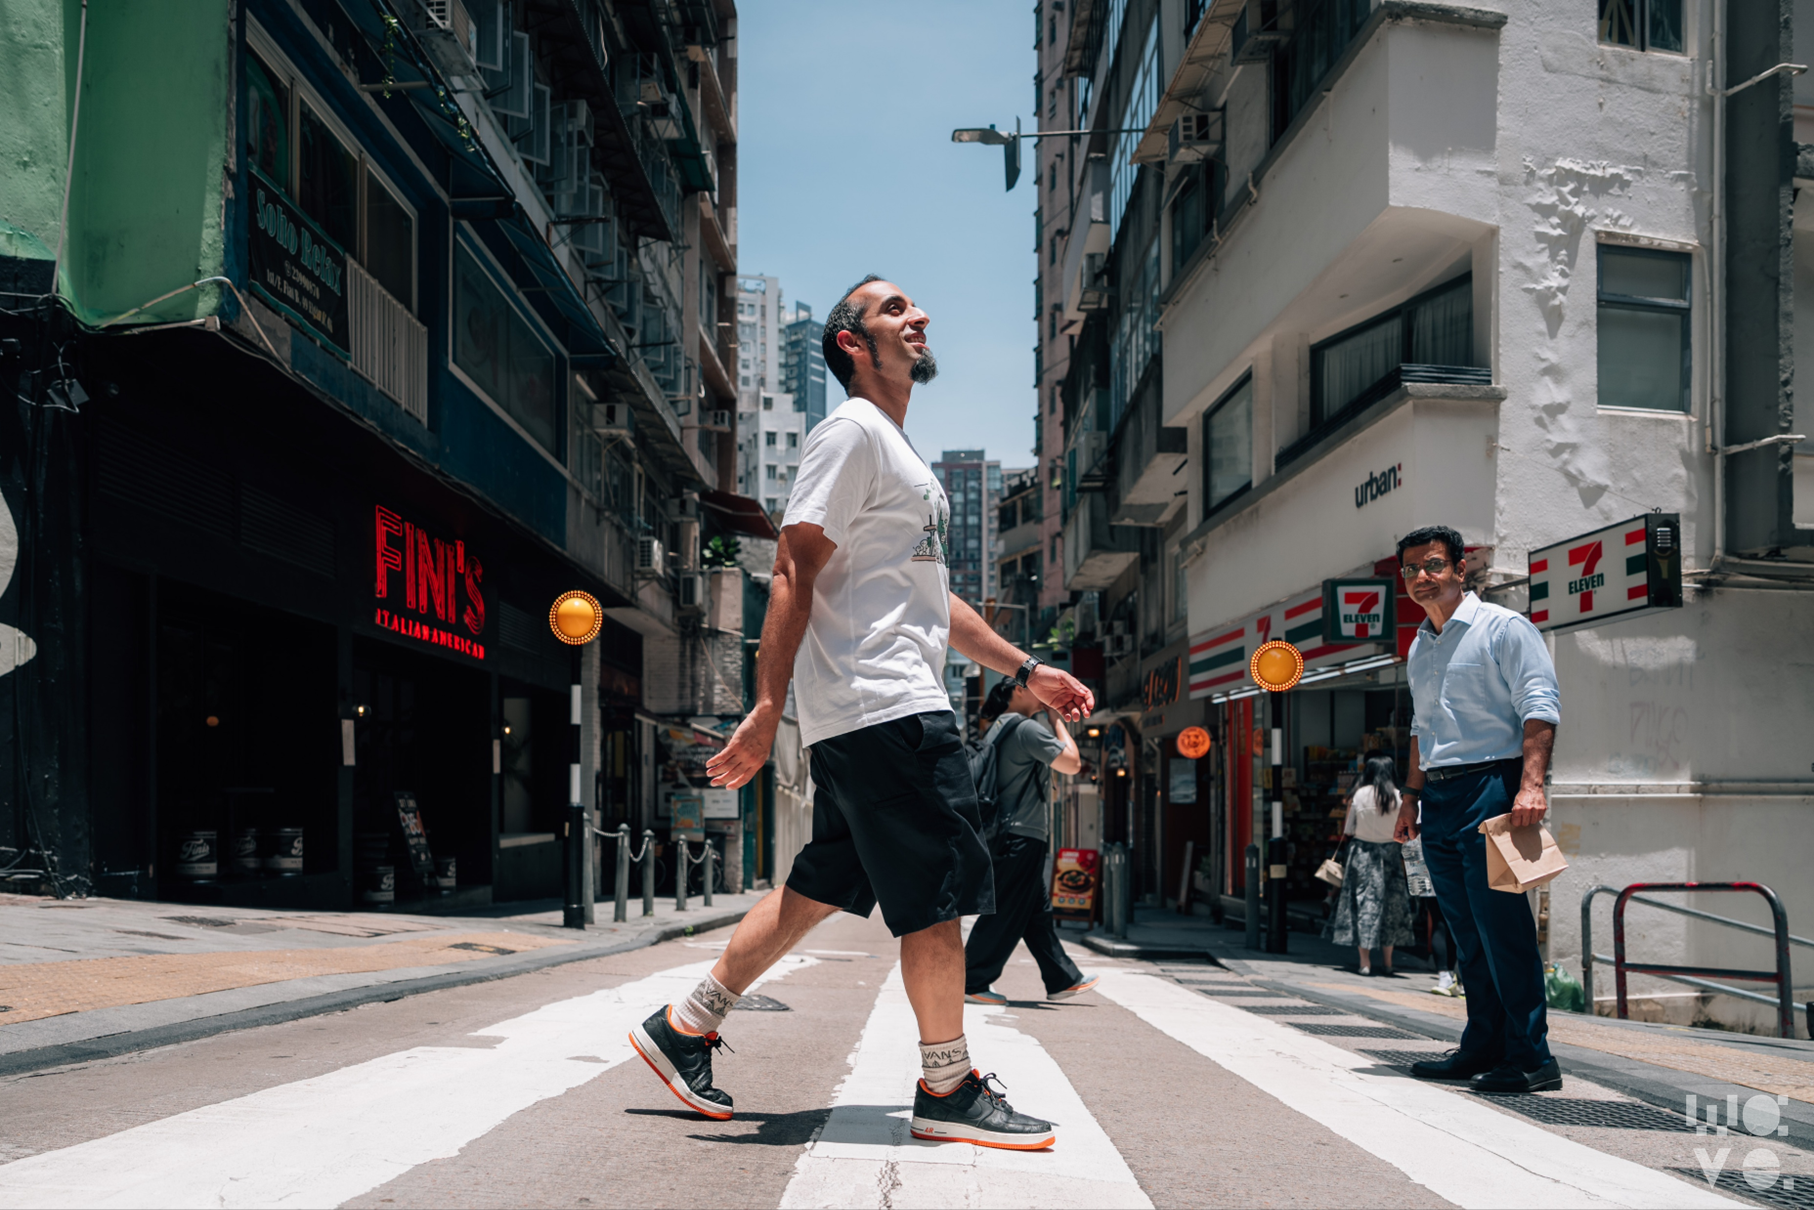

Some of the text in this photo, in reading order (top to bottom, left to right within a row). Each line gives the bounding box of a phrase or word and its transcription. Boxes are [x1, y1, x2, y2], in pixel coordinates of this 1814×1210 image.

[256, 188, 342, 297] Soho Relax
[375, 504, 485, 635] FINI'S
[1568, 540, 1602, 613] 7
[375, 608, 485, 660] ITALIAN AMERICAN
[1344, 591, 1379, 638] 7
[922, 1048, 962, 1060] VANS
